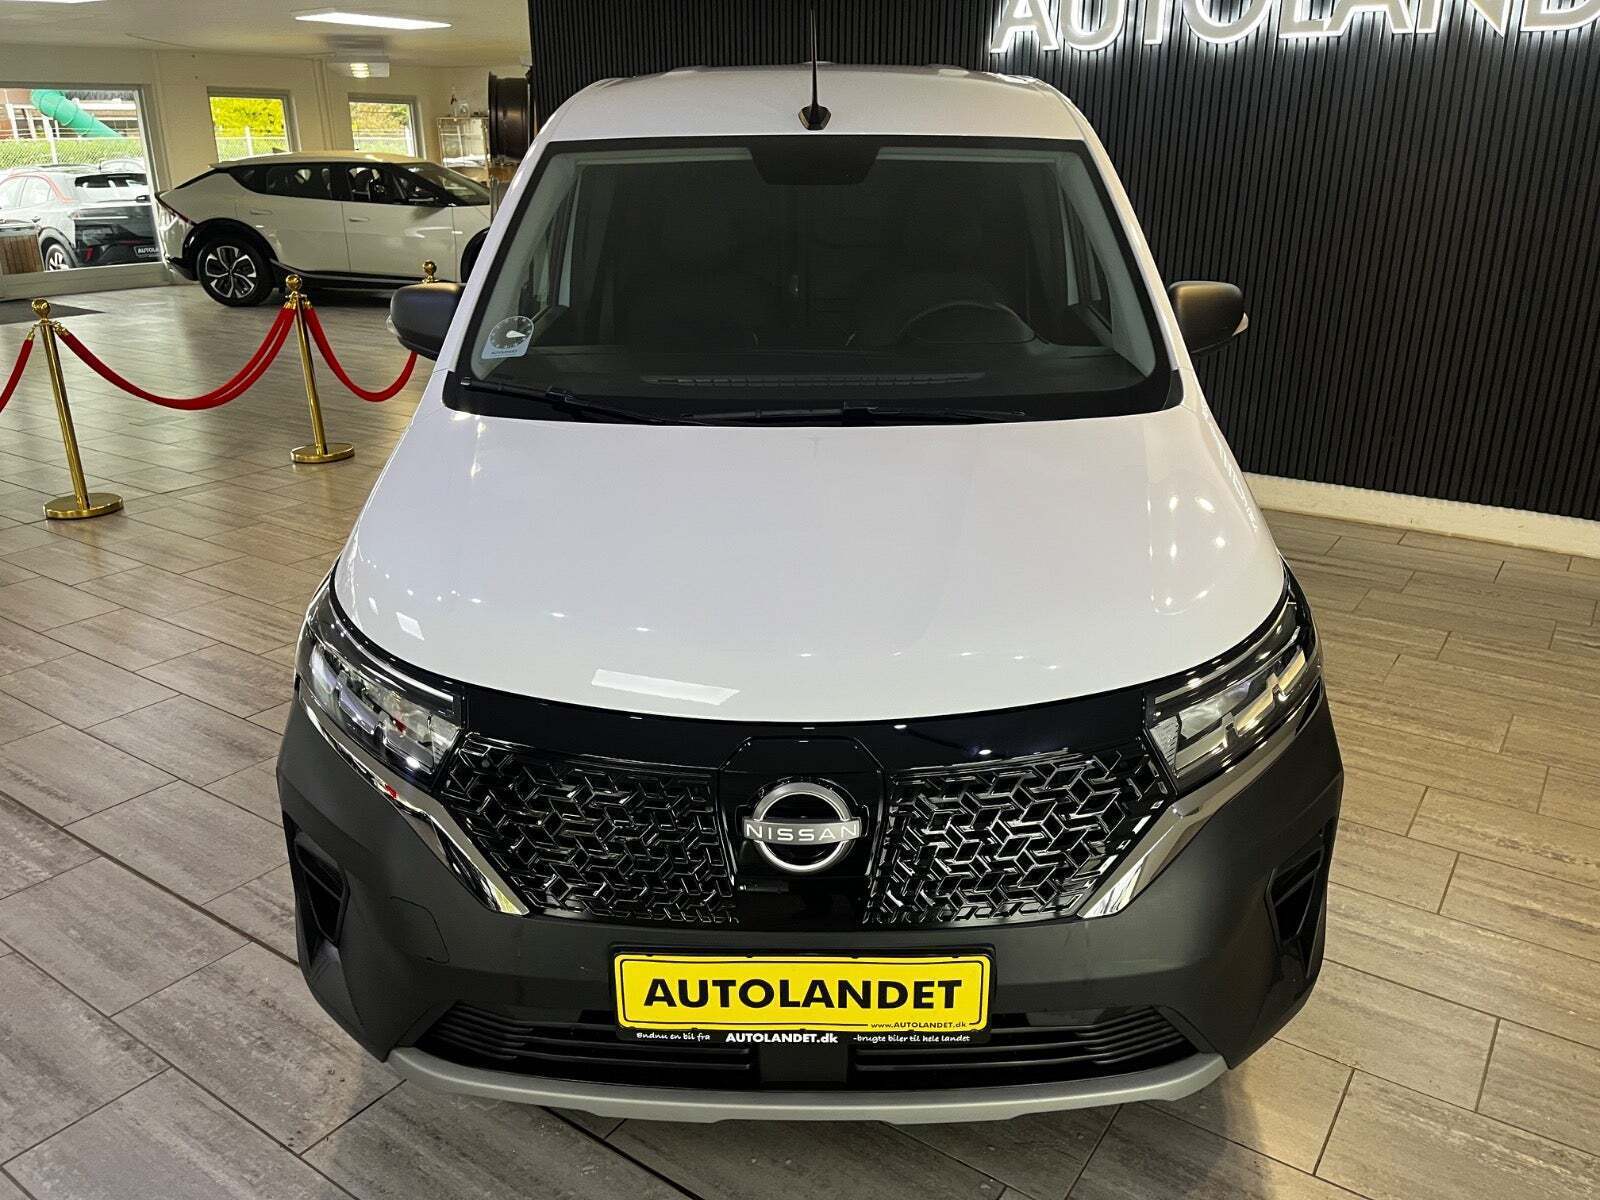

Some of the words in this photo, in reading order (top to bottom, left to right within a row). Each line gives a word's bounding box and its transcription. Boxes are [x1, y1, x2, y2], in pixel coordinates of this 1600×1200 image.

[746, 823, 857, 841] NISSAN
[643, 979, 962, 1009] AUTOLANDET
[870, 1021, 967, 1029] www.AUTOLANDET.dk
[682, 1032, 696, 1040] bil
[696, 1033, 711, 1042] fra
[725, 1032, 839, 1043] AUTOLANDET.dk
[887, 1034, 909, 1042] biler
[909, 1034, 921, 1042] til
[922, 1034, 939, 1042] hele
[941, 1034, 970, 1042] landet
